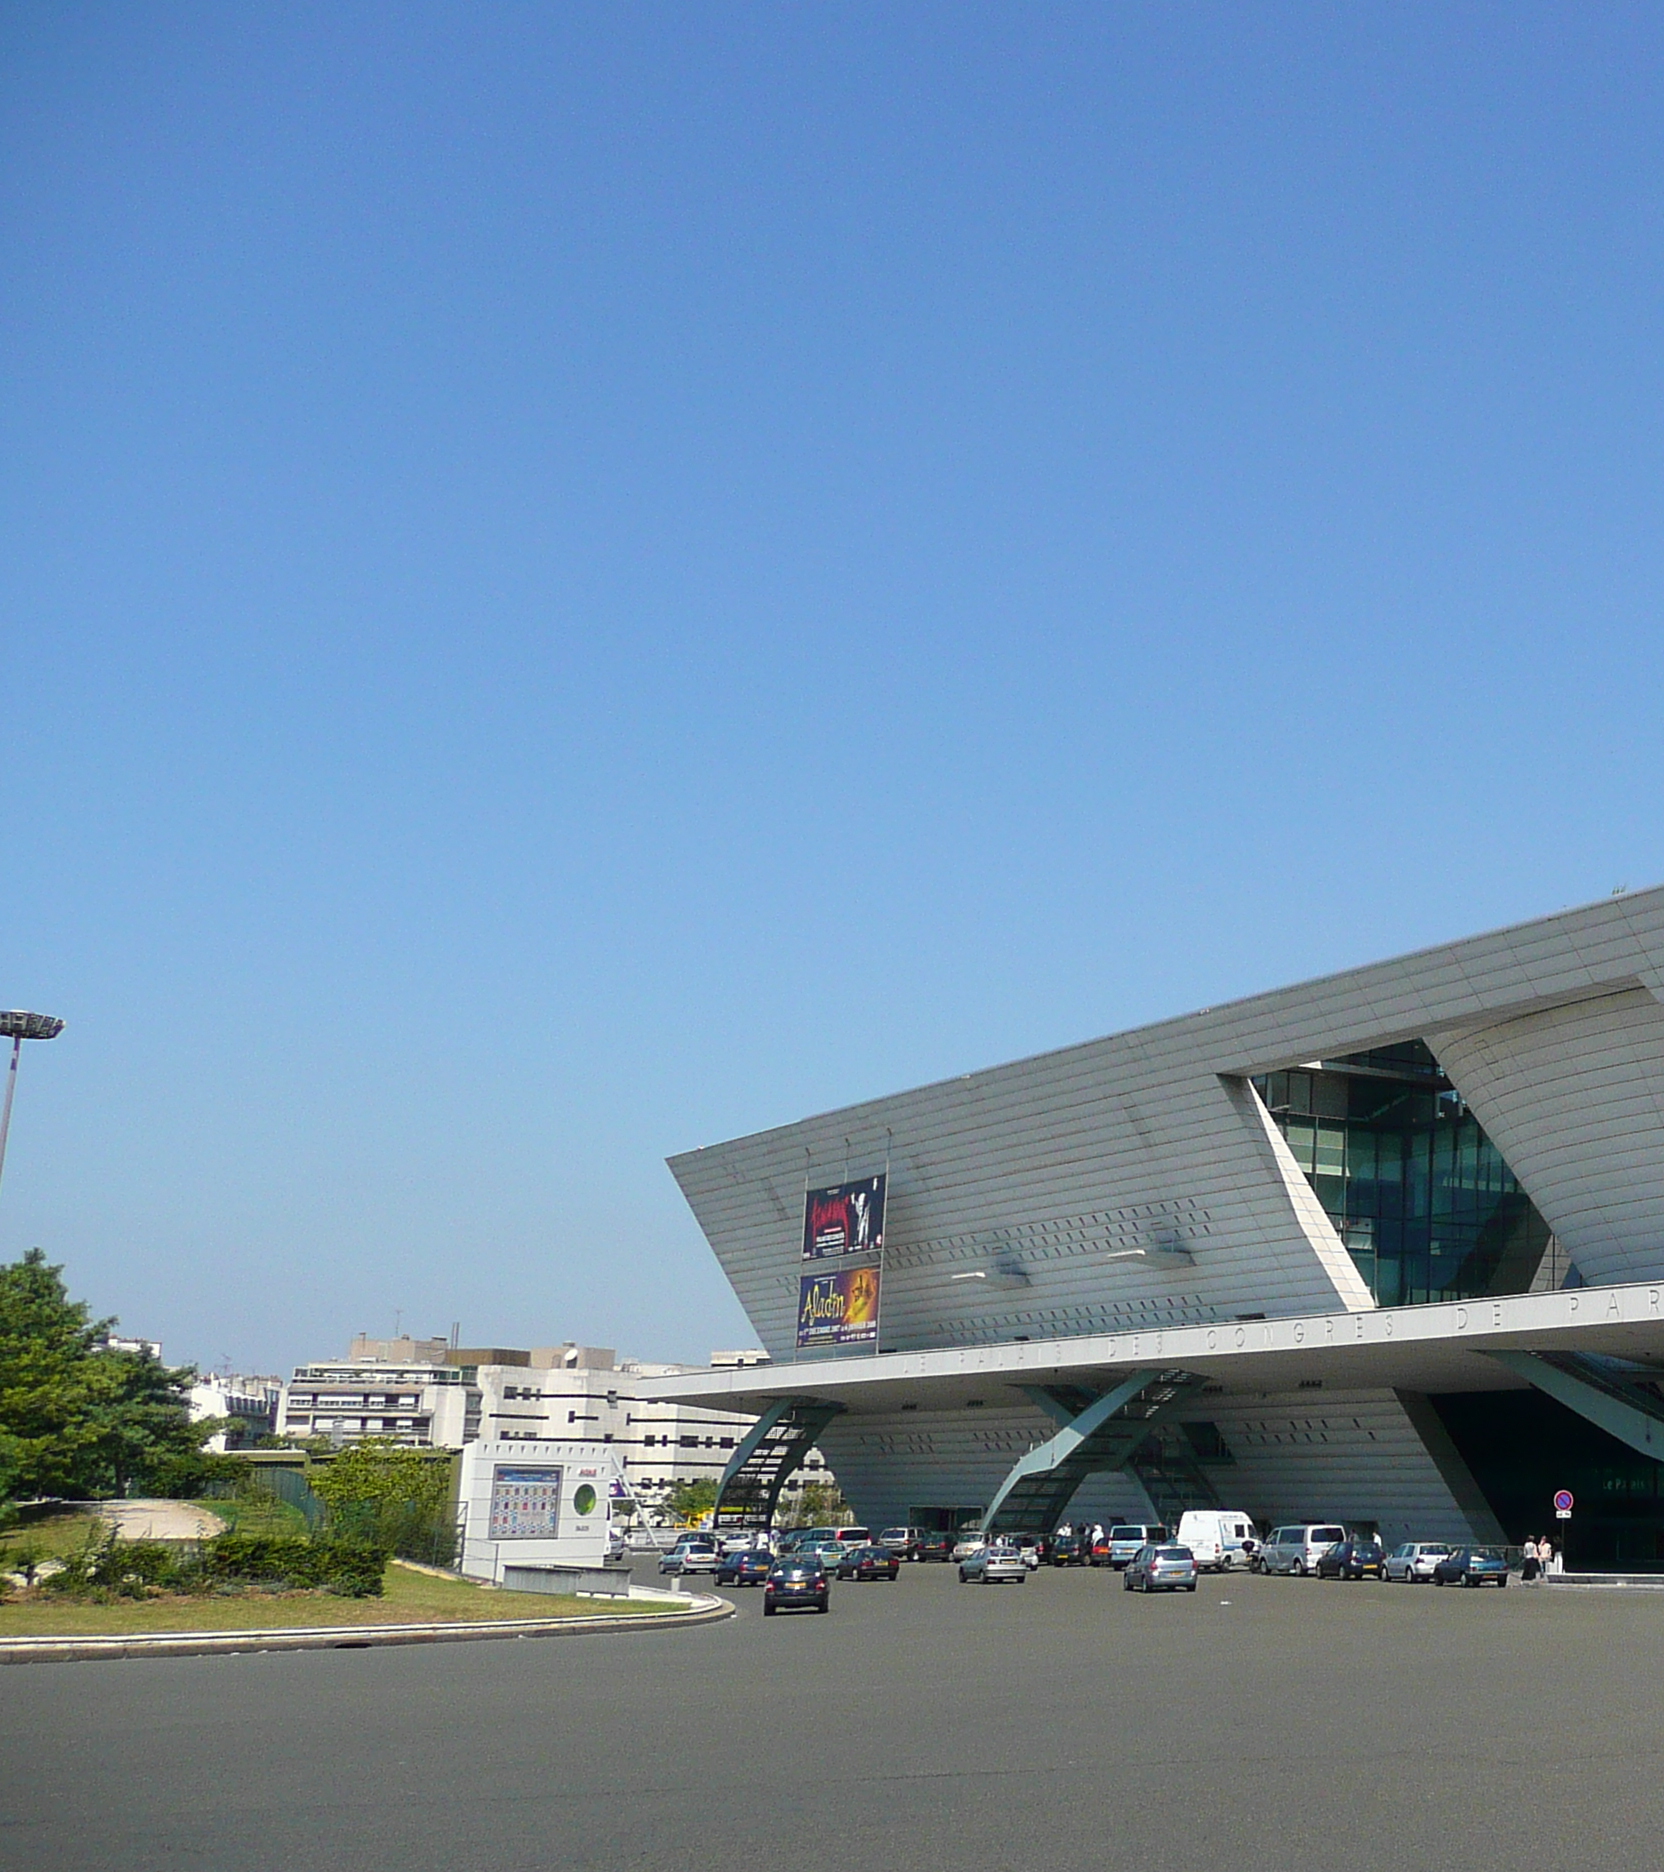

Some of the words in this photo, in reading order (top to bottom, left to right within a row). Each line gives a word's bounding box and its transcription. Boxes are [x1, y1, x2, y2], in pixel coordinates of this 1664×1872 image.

[801, 1280, 845, 1327] Aladin
[1109, 1334, 1162, 1357] DES
[1457, 1304, 1501, 1329] DE
